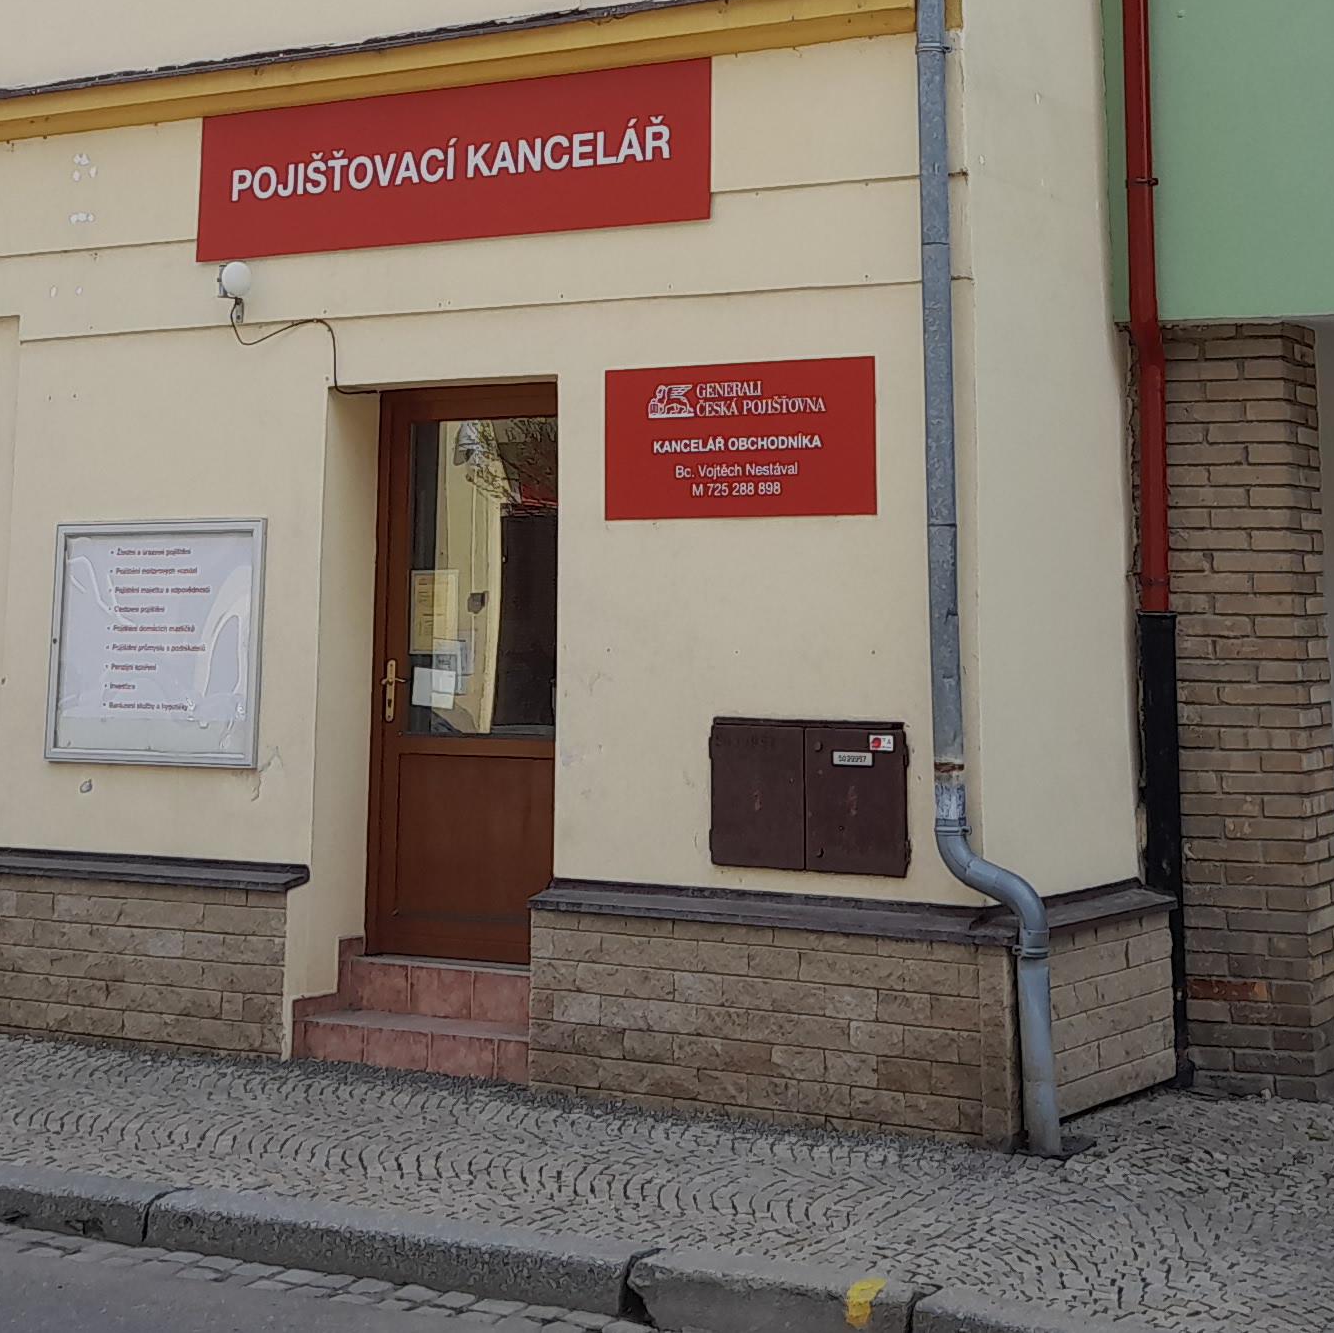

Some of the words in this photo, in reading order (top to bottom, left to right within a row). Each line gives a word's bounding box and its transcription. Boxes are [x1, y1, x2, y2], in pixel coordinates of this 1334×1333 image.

[231, 138, 458, 201] POJIŠŤOVACÍ
[466, 115, 671, 178] KANCELÁŘ
[696, 380, 762, 398] GENERALI
[696, 398, 739, 418] ČESKÁ
[742, 395, 827, 415] POJIŠŤOVNA
[652, 435, 725, 454] KANCELÁŘ
[727, 432, 822, 451] OBCHODNÍKA
[675, 465, 695, 479] Bc.
[698, 463, 742, 480] Vojtěch
[692, 483, 704, 497] M
[707, 483, 729, 497] 725
[732, 482, 755, 496] 288
[758, 481, 782, 495] 898
